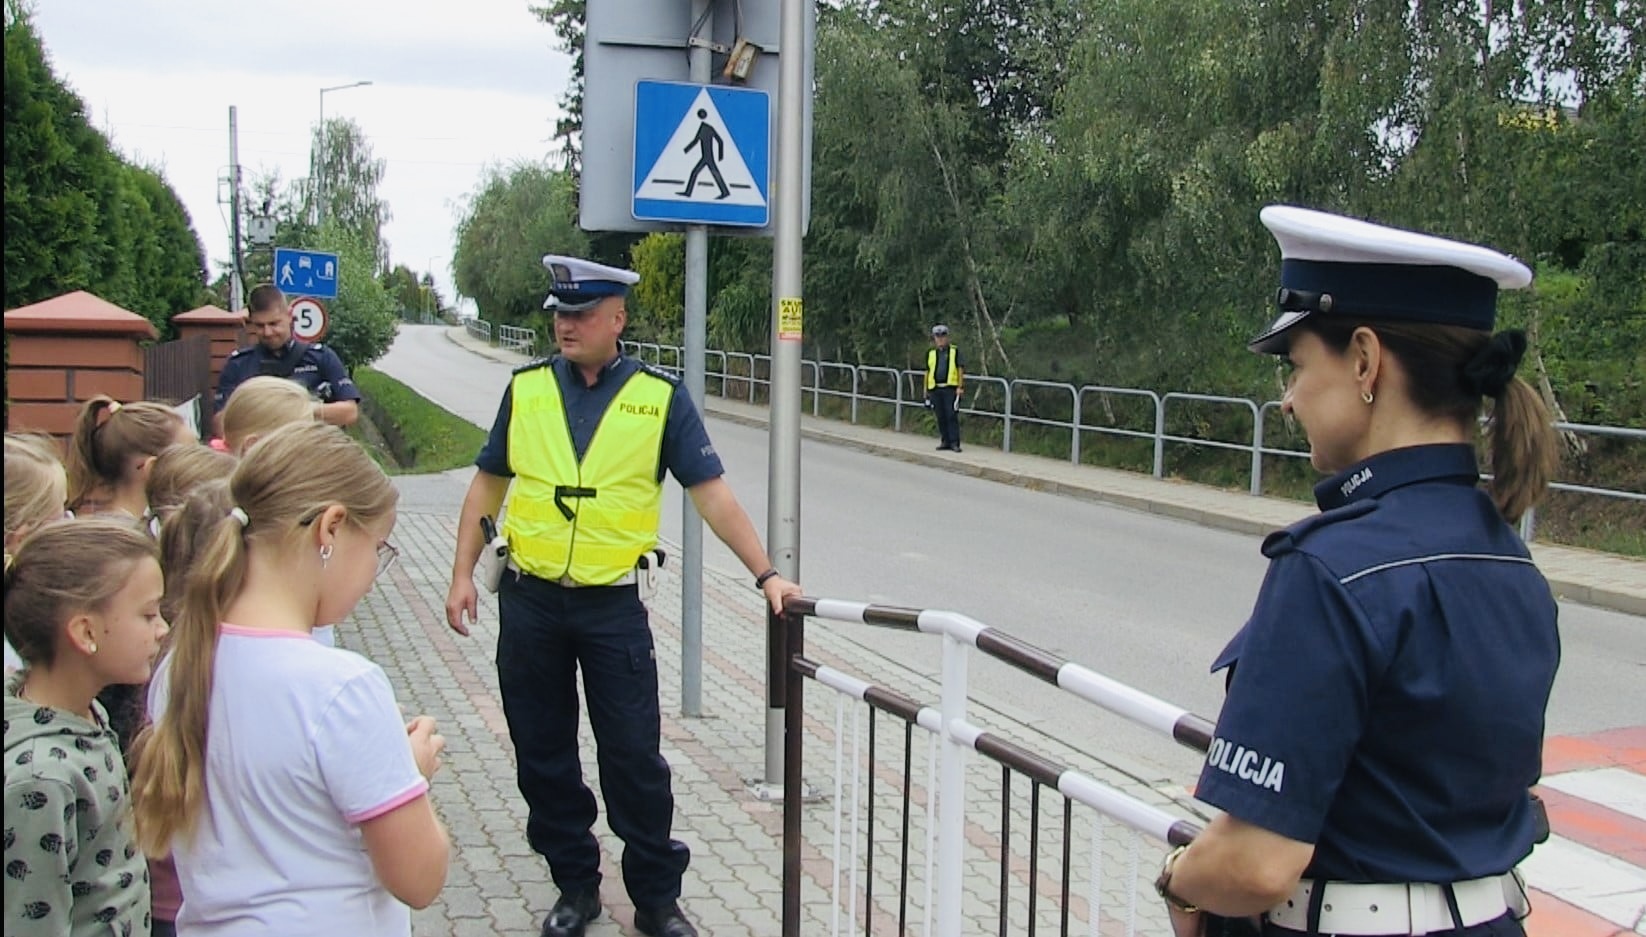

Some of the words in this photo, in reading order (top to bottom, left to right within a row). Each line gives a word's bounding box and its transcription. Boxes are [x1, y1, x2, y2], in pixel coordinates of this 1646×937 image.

[301, 309, 312, 328] 5
[620, 403, 660, 417] POLICJA
[1340, 467, 1373, 497] POLICJA
